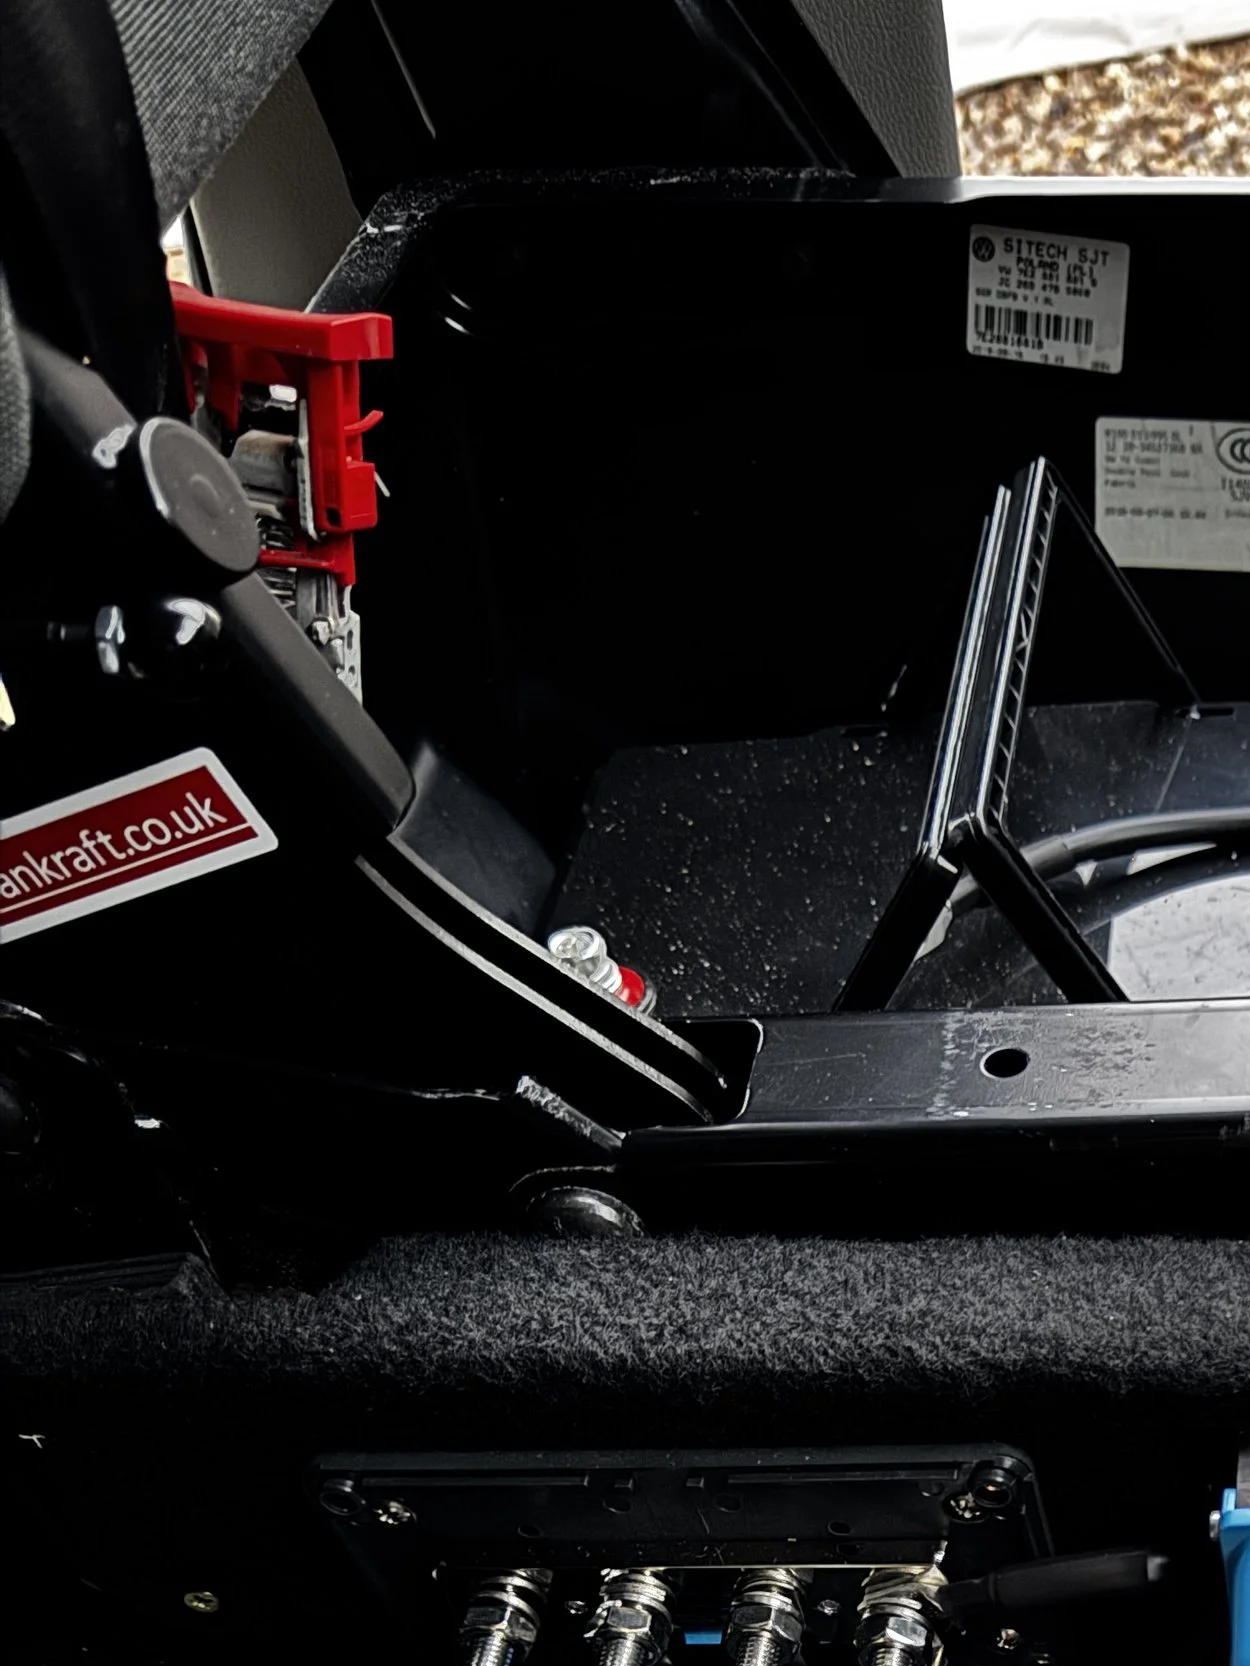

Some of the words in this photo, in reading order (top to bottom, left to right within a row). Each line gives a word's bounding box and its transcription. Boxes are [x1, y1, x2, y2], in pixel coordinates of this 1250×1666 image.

[1004, 238, 1067, 261] SITECH
[1078, 248, 1109, 267] SJT
[1017, 256, 1059, 271] POLAND
[0, 792, 228, 899] ankraft.co.uk
